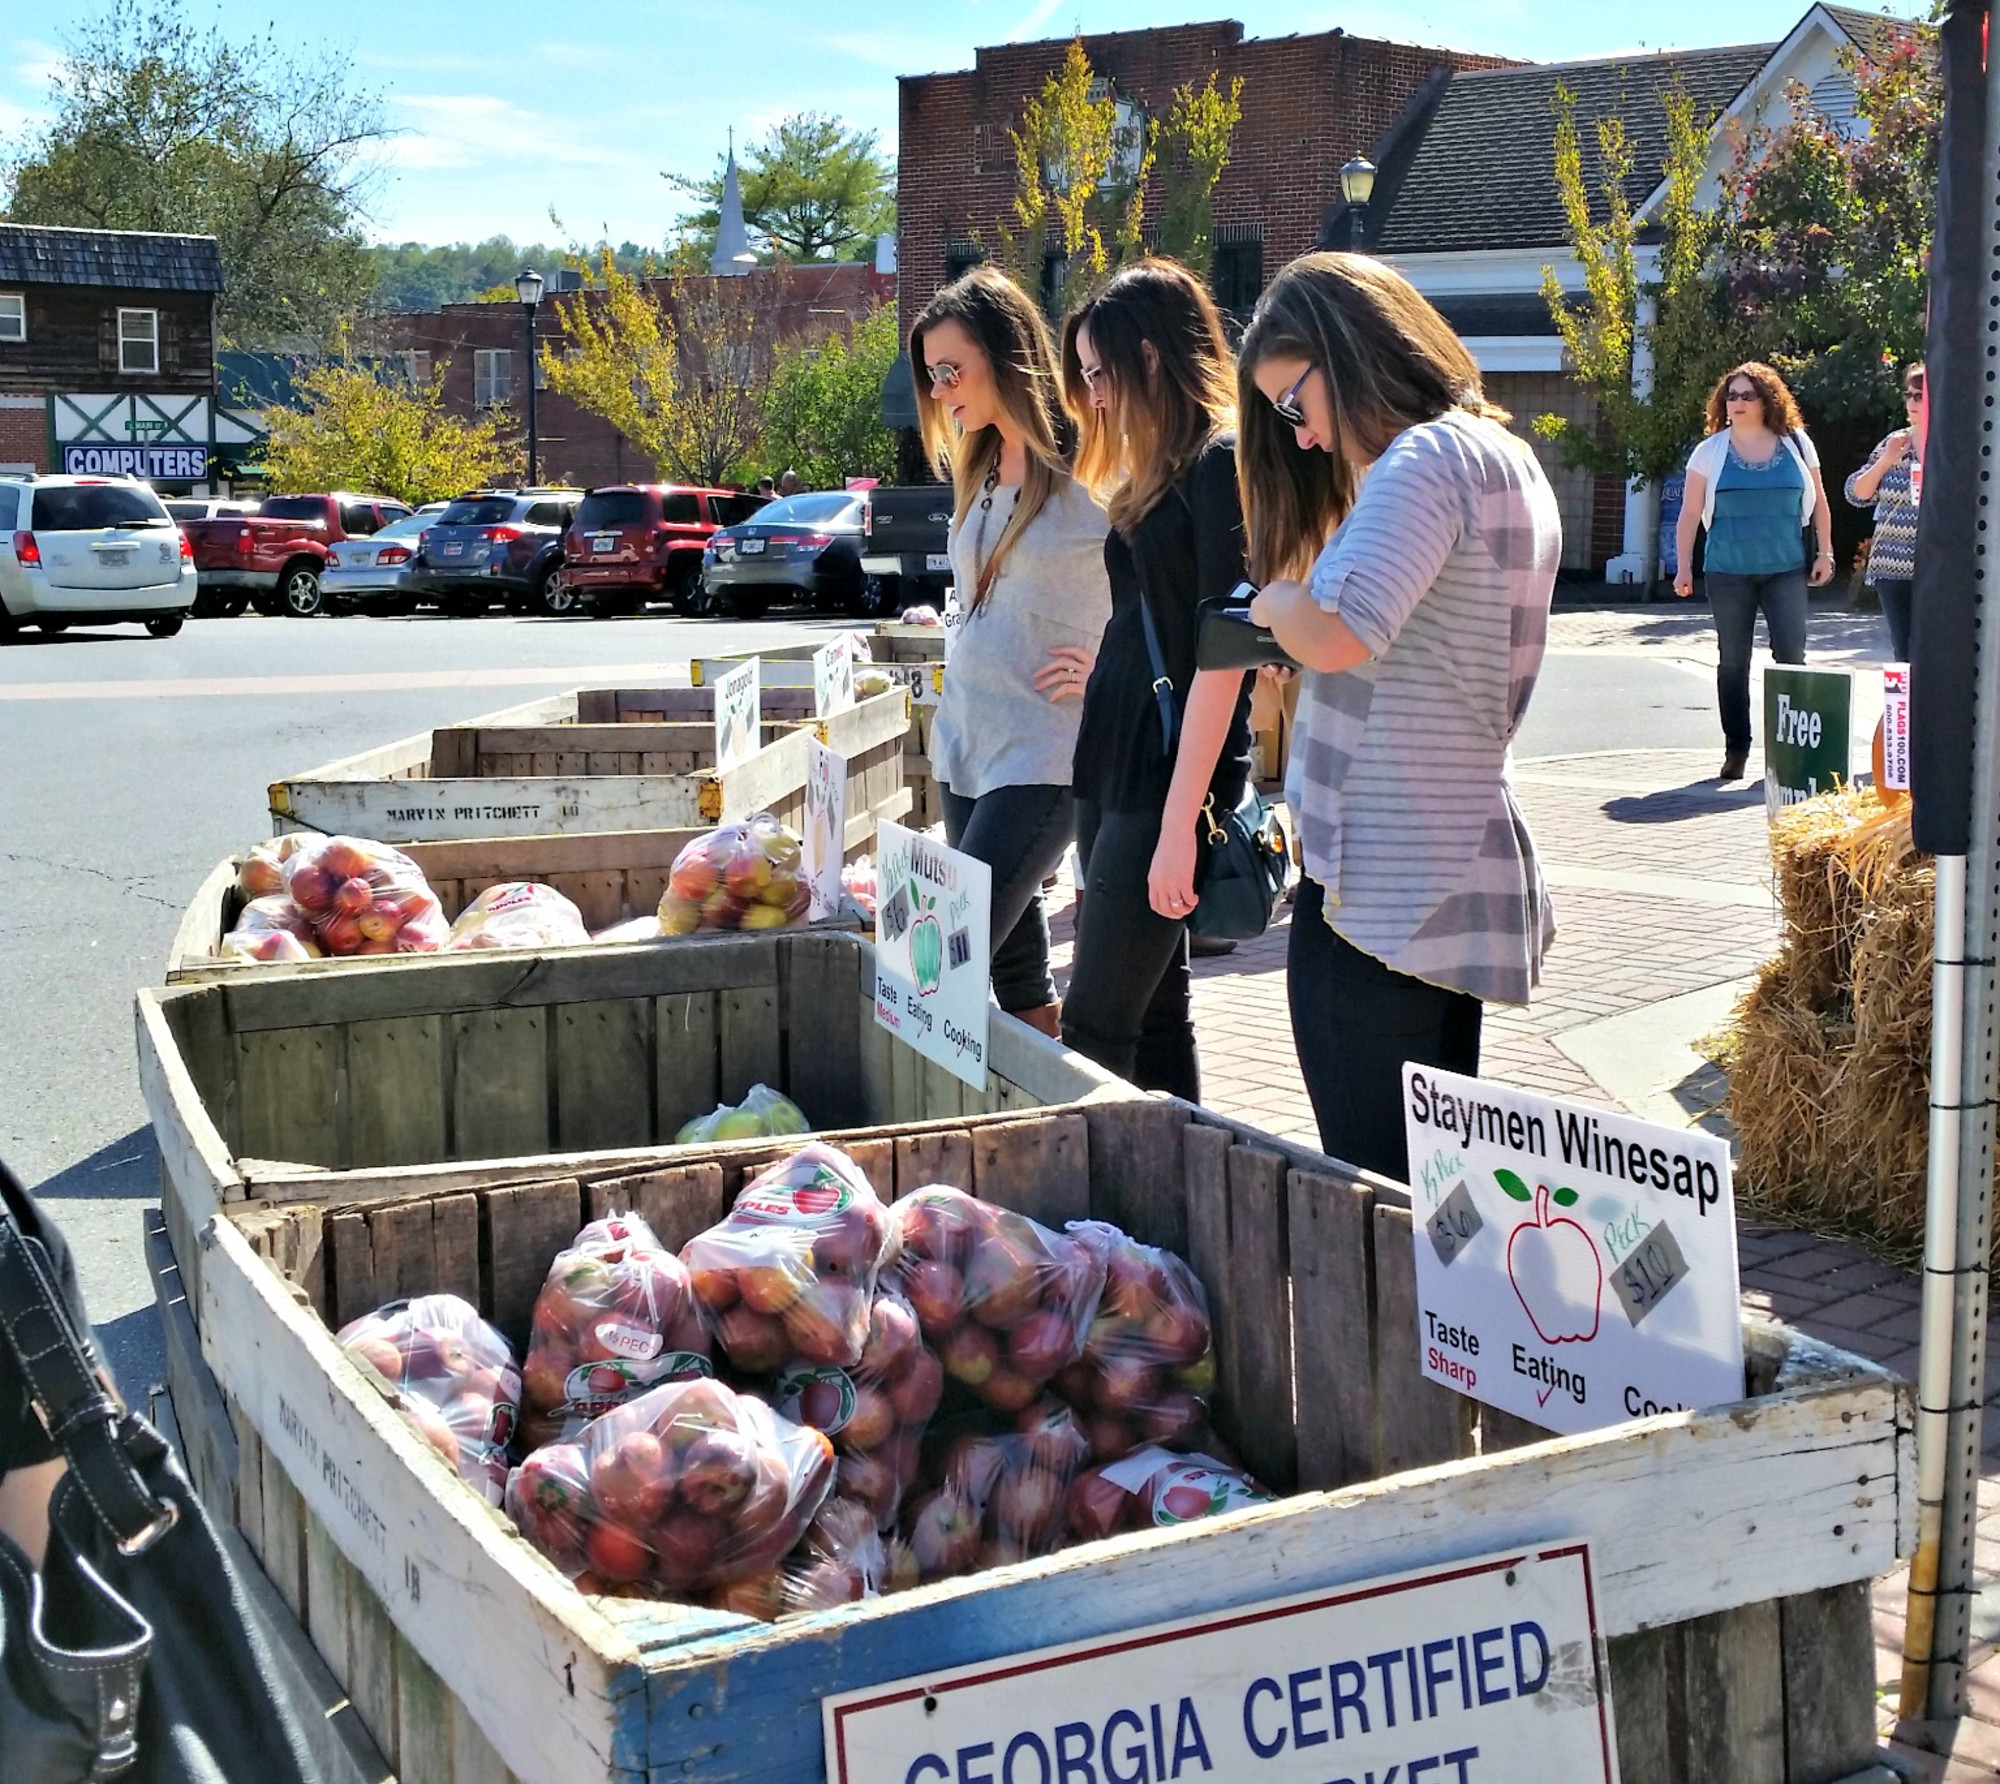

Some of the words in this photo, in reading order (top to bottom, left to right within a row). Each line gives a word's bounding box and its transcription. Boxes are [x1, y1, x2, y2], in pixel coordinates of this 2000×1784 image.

[136, 421, 153, 429] MAIN
[68, 449, 204, 476] COMPUTERS
[1776, 693, 1822, 749] Free
[1897, 701, 1907, 784] FLAGS100.COM
[386, 807, 446, 822] MARVIN
[454, 805, 541, 820] PRITCHETT
[910, 838, 958, 892] Mutsu
[878, 976, 897, 1004] Taste
[877, 1000, 901, 1029] Medium
[907, 995, 933, 1032] Eating
[944, 1019, 982, 1063] Cooking
[1411, 1072, 1546, 1158] Staymen
[1555, 1109, 1719, 1216] Winesap
[735, 1200, 792, 1216] PLES
[619, 1336, 652, 1355] PEC
[1425, 1310, 1480, 1356] Taste
[1428, 1347, 1477, 1390] Sharp
[1512, 1343, 1586, 1404] Eating
[1243, 1620, 1551, 1759] CERTIFIED
